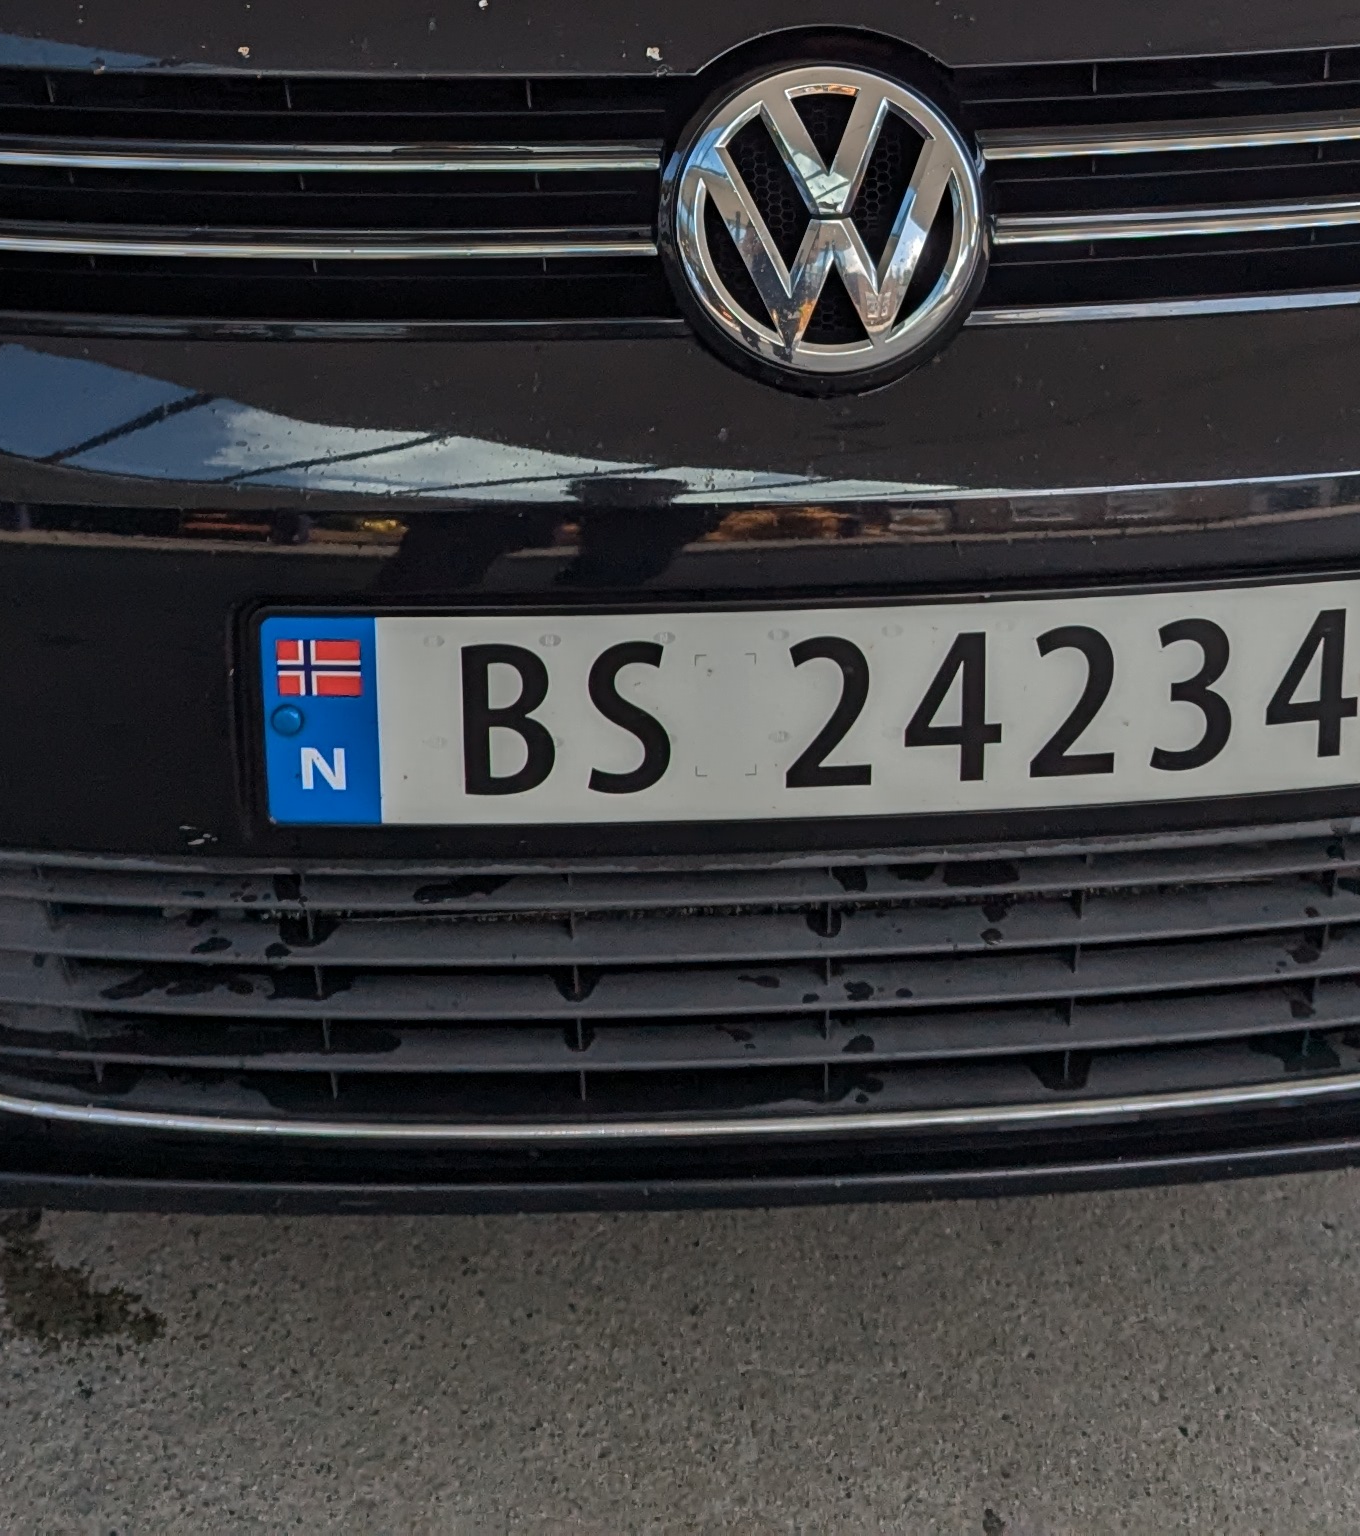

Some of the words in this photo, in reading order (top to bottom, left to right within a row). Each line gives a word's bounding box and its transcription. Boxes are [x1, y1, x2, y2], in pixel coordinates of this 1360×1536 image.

[680, 69, 977, 368] VW
[300, 747, 347, 791] N
[461, 641, 670, 795] BS
[786, 609, 1357, 788] 24234
